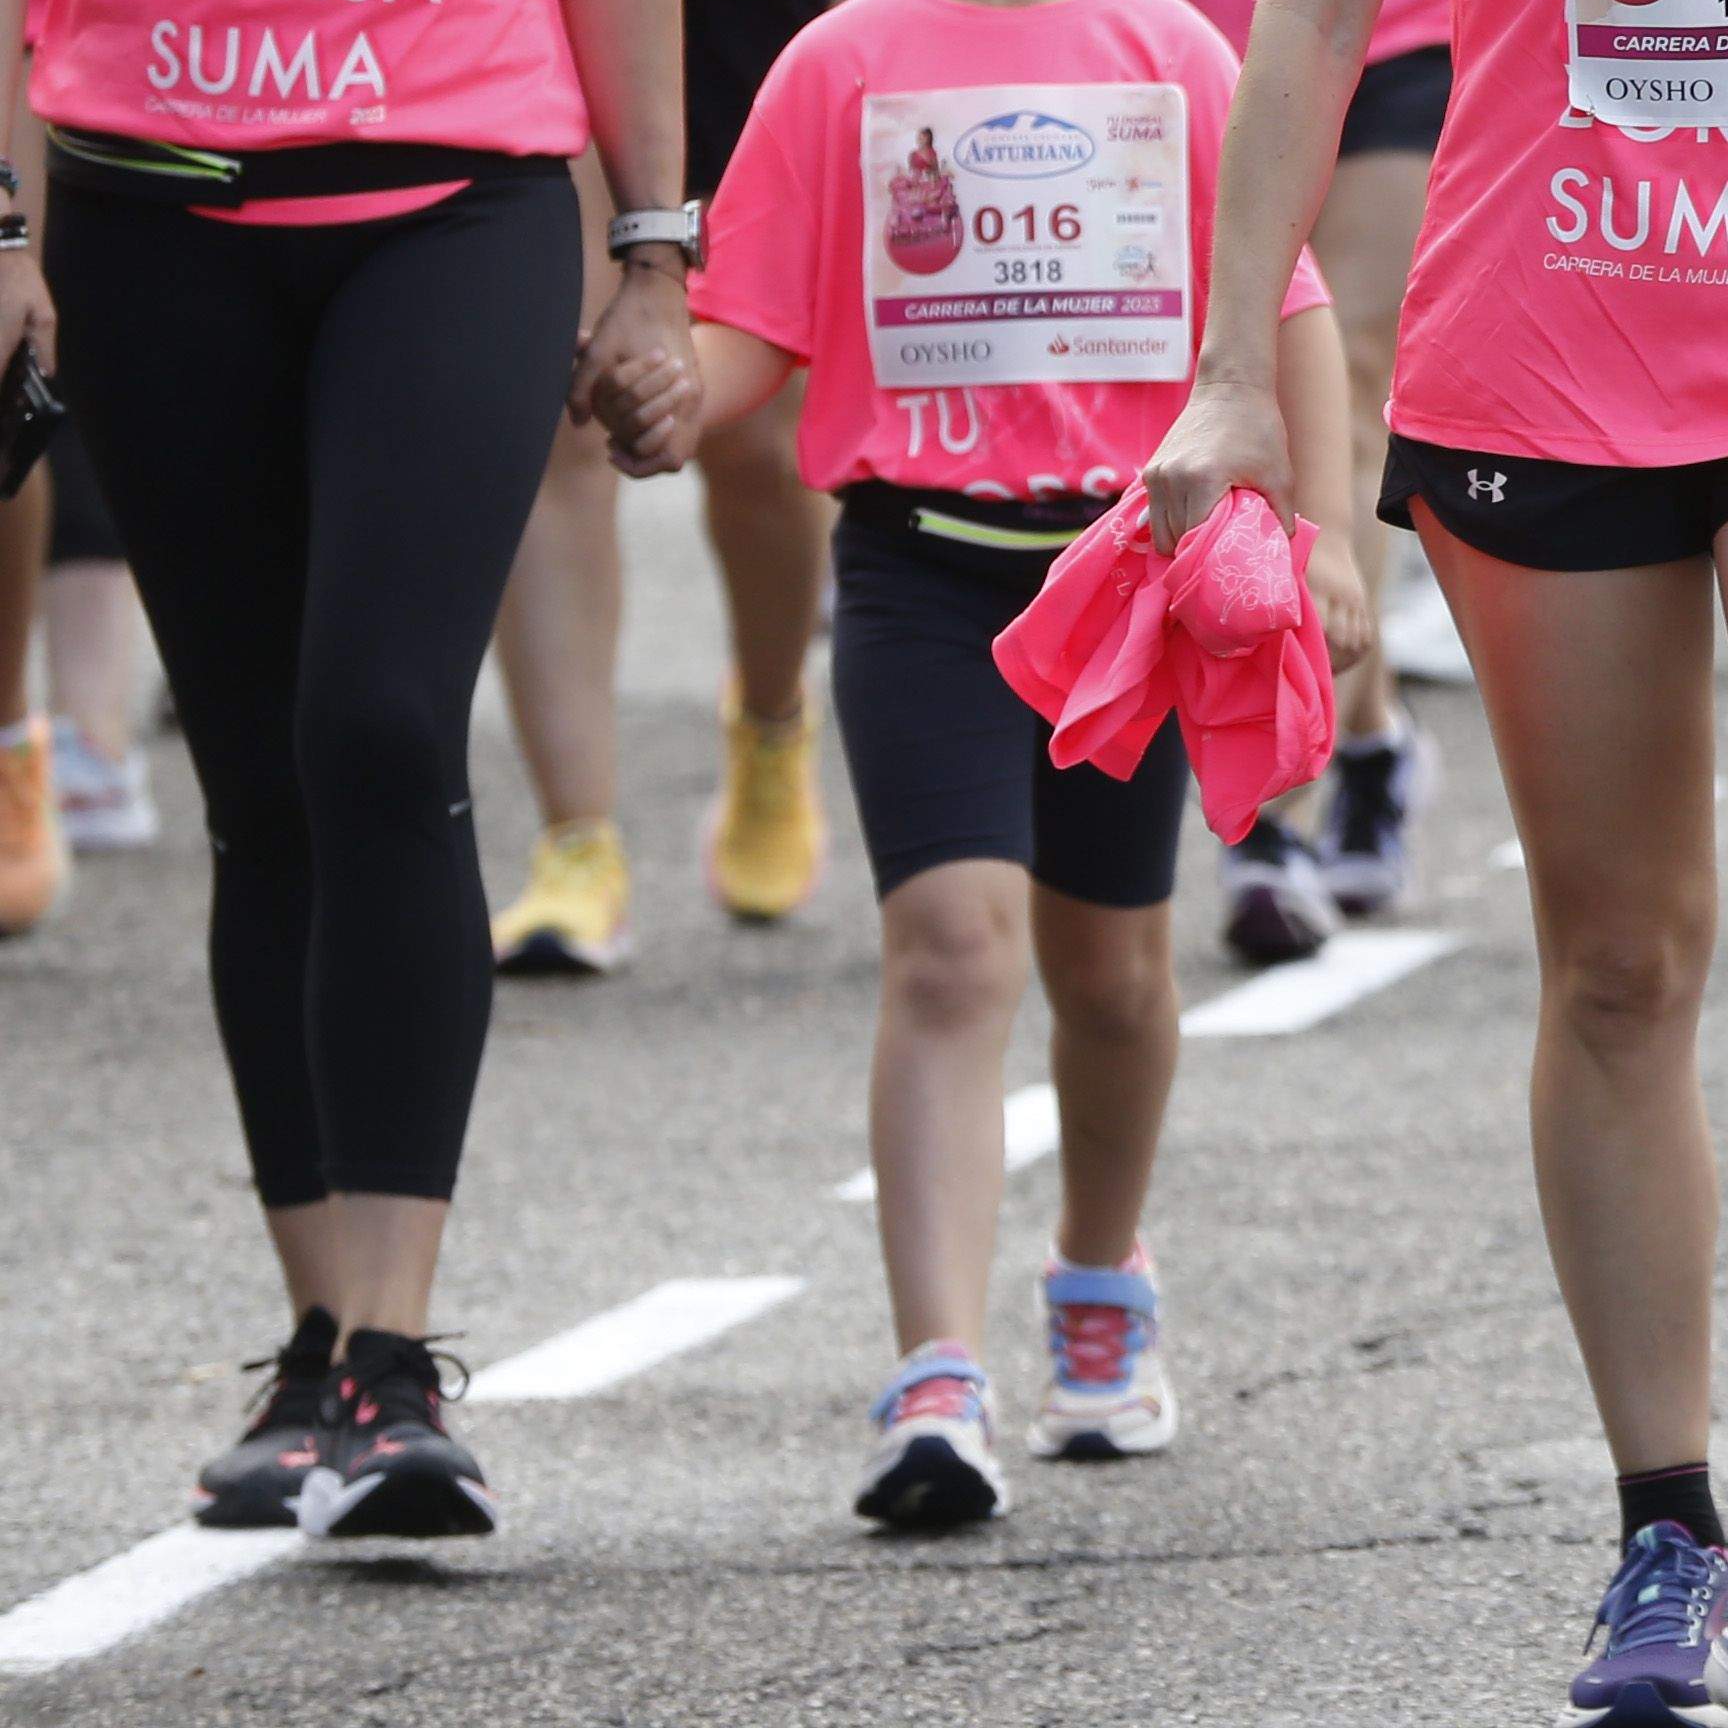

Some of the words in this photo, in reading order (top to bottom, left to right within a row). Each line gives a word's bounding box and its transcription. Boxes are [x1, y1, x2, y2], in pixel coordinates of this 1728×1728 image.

[1613, 35, 1710, 52] CARRERA
[147, 19, 386, 101] SUMA
[1605, 77, 1713, 103] OYSHO
[1106, 126, 1163, 142] SUMA
[965, 138, 1086, 164] ASTURIANA
[973, 203, 1082, 245] 016
[994, 259, 1063, 284] 3818
[1629, 264, 1656, 281] DE
[1658, 265, 1682, 283] LA
[904, 300, 987, 320] CARRERA
[993, 298, 1018, 315] DE
[1023, 297, 1047, 314] LA
[1051, 296, 1115, 313] MUJER
[900, 339, 991, 365] OYSHO
[1073, 336, 1169, 357] Santander
[896, 386, 981, 458] TU
